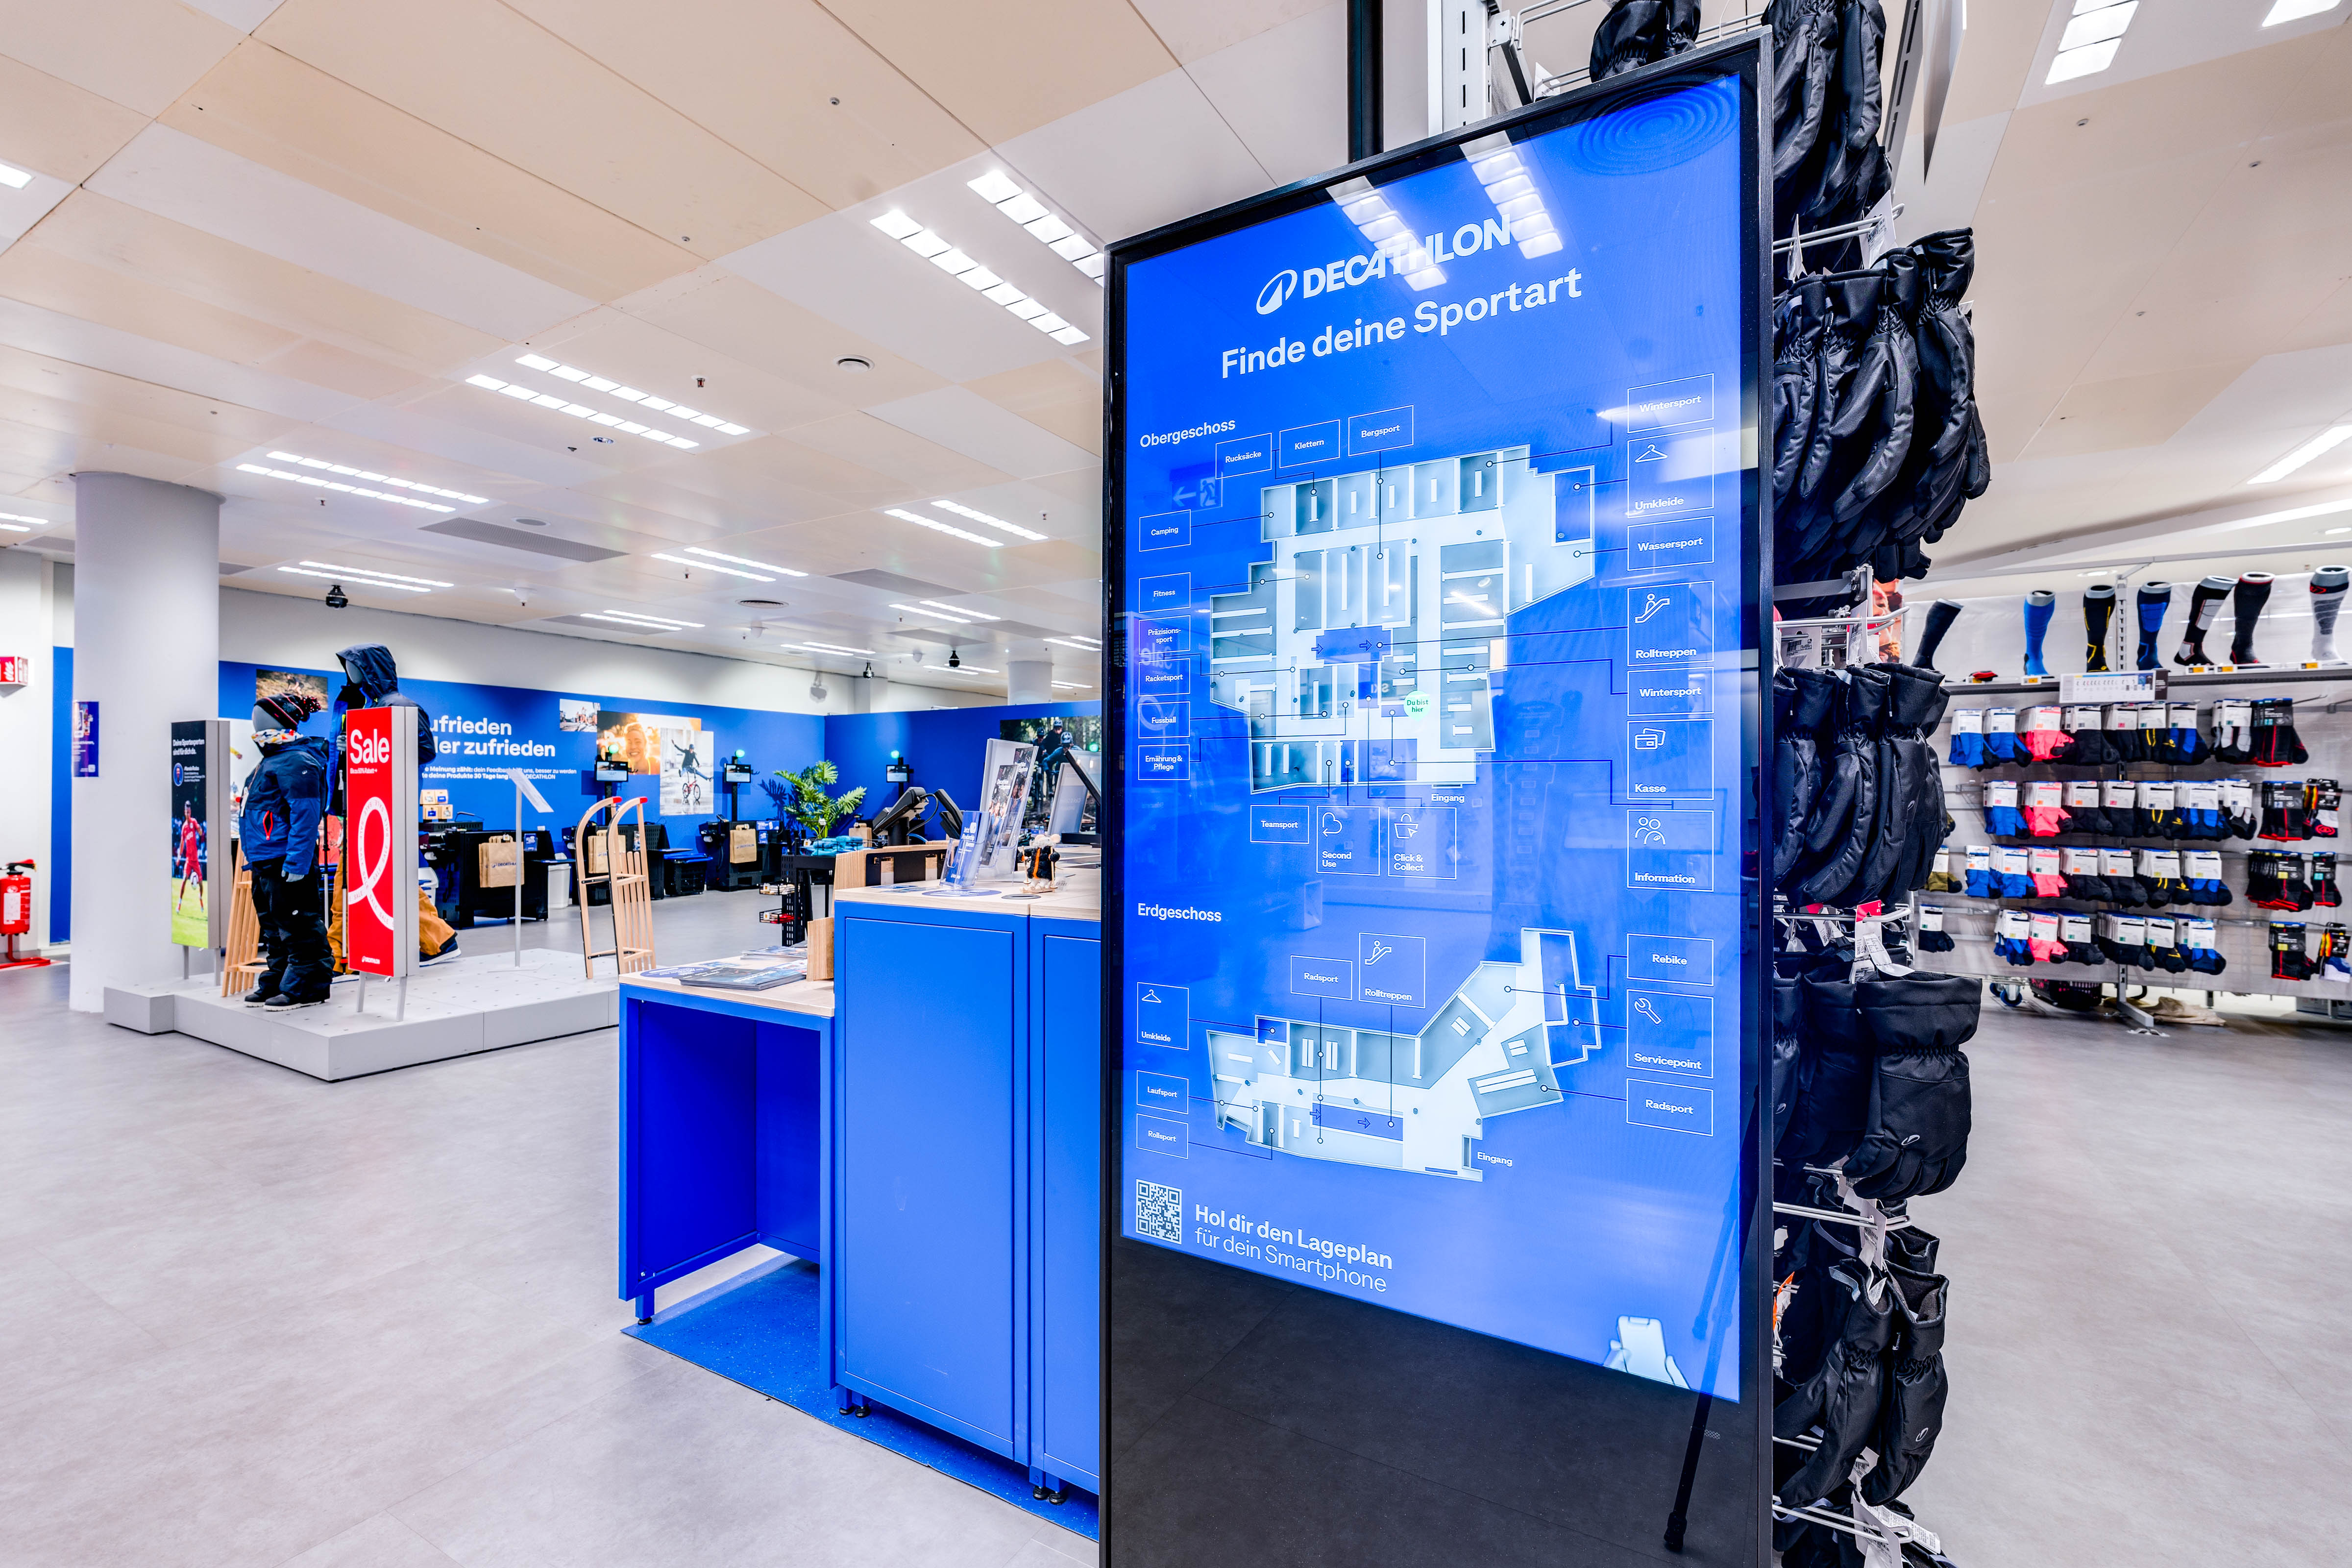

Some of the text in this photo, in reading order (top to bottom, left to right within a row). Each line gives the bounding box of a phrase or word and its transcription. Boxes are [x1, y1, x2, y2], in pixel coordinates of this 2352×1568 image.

[1303, 214, 1511, 299] DECATHLON
[1222, 268, 1582, 379] Finde deine Sportart
[1639, 395, 1702, 413] Wintersport
[1140, 419, 1236, 447] Obergeschoss
[1361, 424, 1400, 439] Bergsport
[1294, 440, 1324, 450] Klettern
[1225, 450, 1262, 464] Rucksäcke
[1635, 496, 1685, 510] Umkleide
[1151, 526, 1179, 537] Camping
[1638, 537, 1703, 552] Wassersport
[1153, 589, 1176, 598] Fitness
[1148, 627, 1181, 637] Präzisions-
[1155, 636, 1173, 644] sport
[1635, 648, 1697, 659] Rolltreppen
[1145, 674, 1183, 683] Racketsport
[1639, 687, 1702, 698] Wintersport
[430, 715, 512, 735] ufrieden
[350, 729, 390, 764] Sale
[464, 738, 556, 757] zufrieden
[1145, 755, 1177, 764] Ernährung
[1153, 762, 1175, 771] Pflege
[1635, 784, 1666, 793] Kasse
[1431, 793, 1466, 804] Eingang
[1261, 820, 1298, 829] Teamsport
[1322, 851, 1352, 860] Second
[1394, 853, 1415, 862] Click
[1322, 859, 1337, 868] Use
[1394, 862, 1424, 872] Collect
[1635, 872, 1696, 884] Information
[1137, 902, 1222, 922] Erdgeschoss
[1652, 954, 1688, 966] Rebike
[1303, 972, 1339, 984] Radsport
[1364, 987, 1413, 1002] Rolltreppen
[1141, 1031, 1172, 1043] Umkleide
[1634, 1053, 1702, 1071] Servicepoint
[1147, 1086, 1178, 1099] Laufsport
[1645, 1099, 1693, 1115] Radsport
[1148, 1129, 1176, 1143] Rollsport
[1477, 1151, 1513, 1167] Eingang
[1195, 1203, 1393, 1270] Hol dir den Lageplan
[1195, 1227, 1388, 1293] für dein Smartphone
